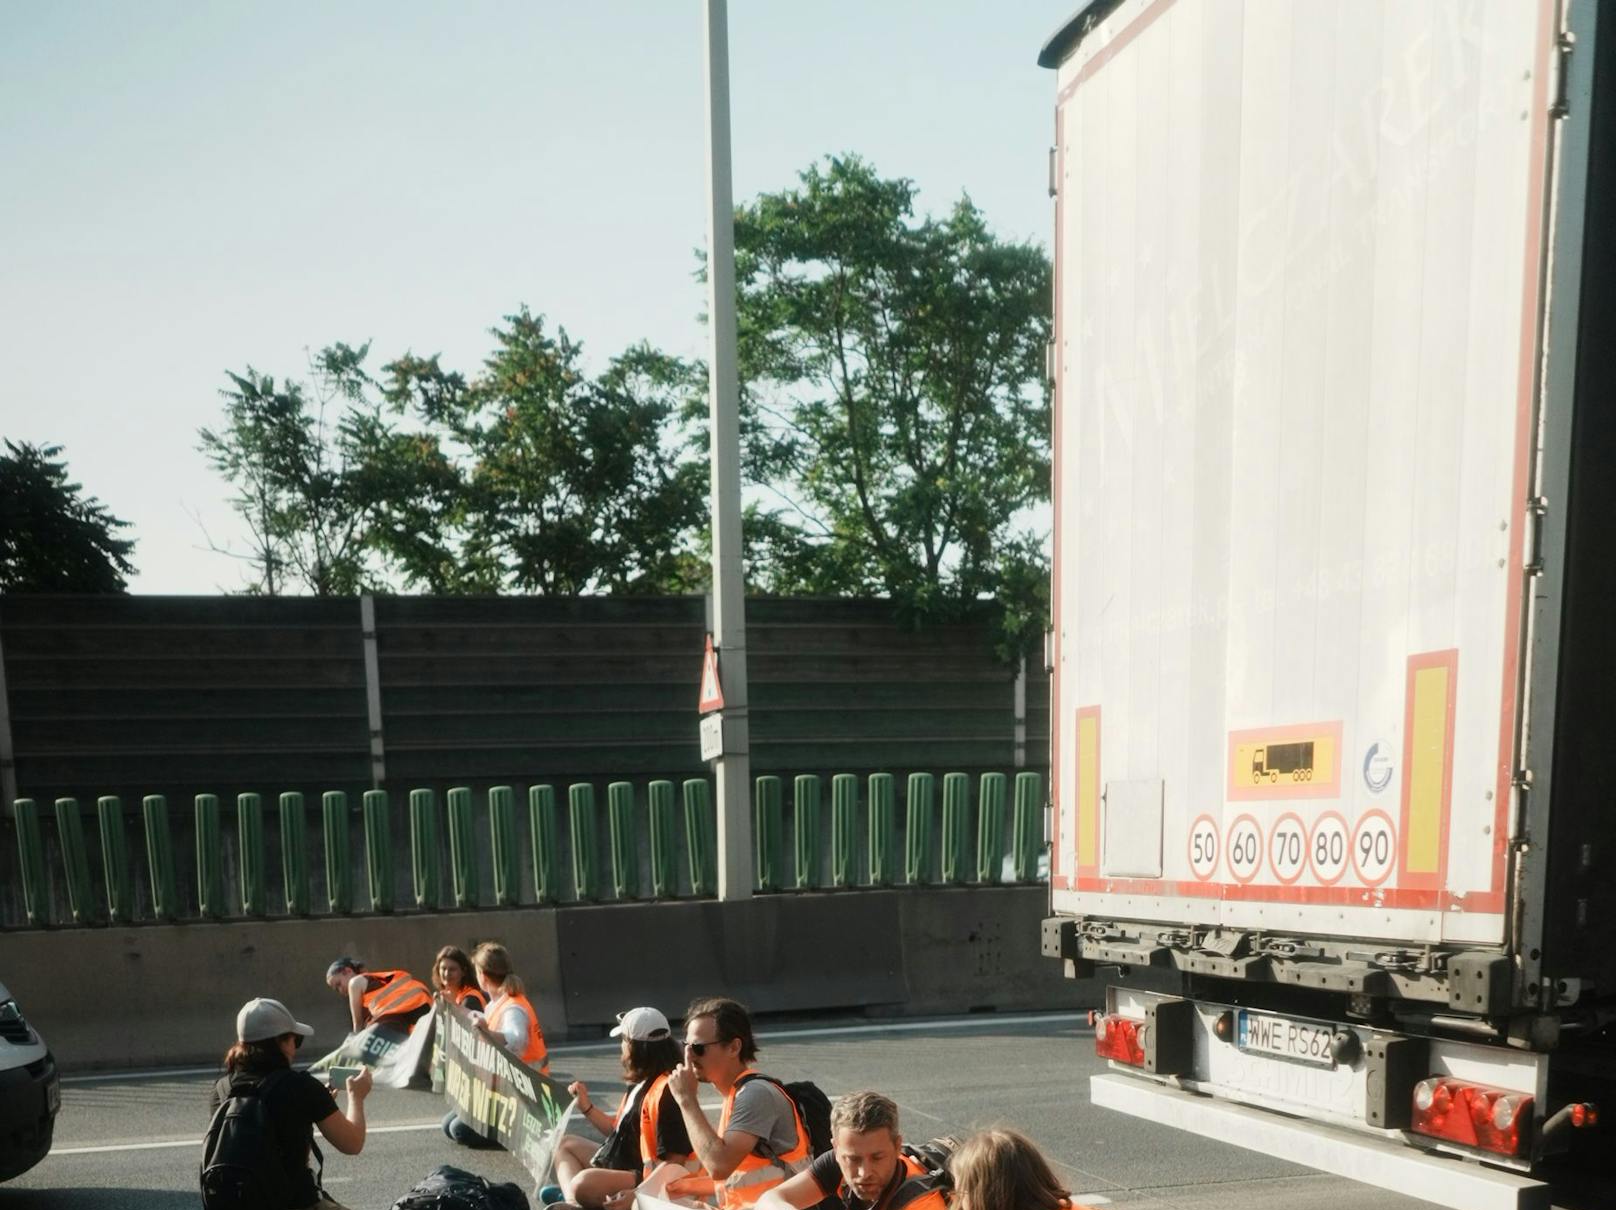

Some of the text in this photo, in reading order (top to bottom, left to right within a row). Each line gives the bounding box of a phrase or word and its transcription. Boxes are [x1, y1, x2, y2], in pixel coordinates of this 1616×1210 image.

[1194, 832, 1215, 864] 50
[1233, 832, 1257, 865] 60
[1276, 832, 1300, 865] 70
[1316, 831, 1343, 866] 80
[1360, 830, 1389, 868] 90
[1250, 1018, 1331, 1059] WWE RS62
[473, 1077, 517, 1138] WITZ?
